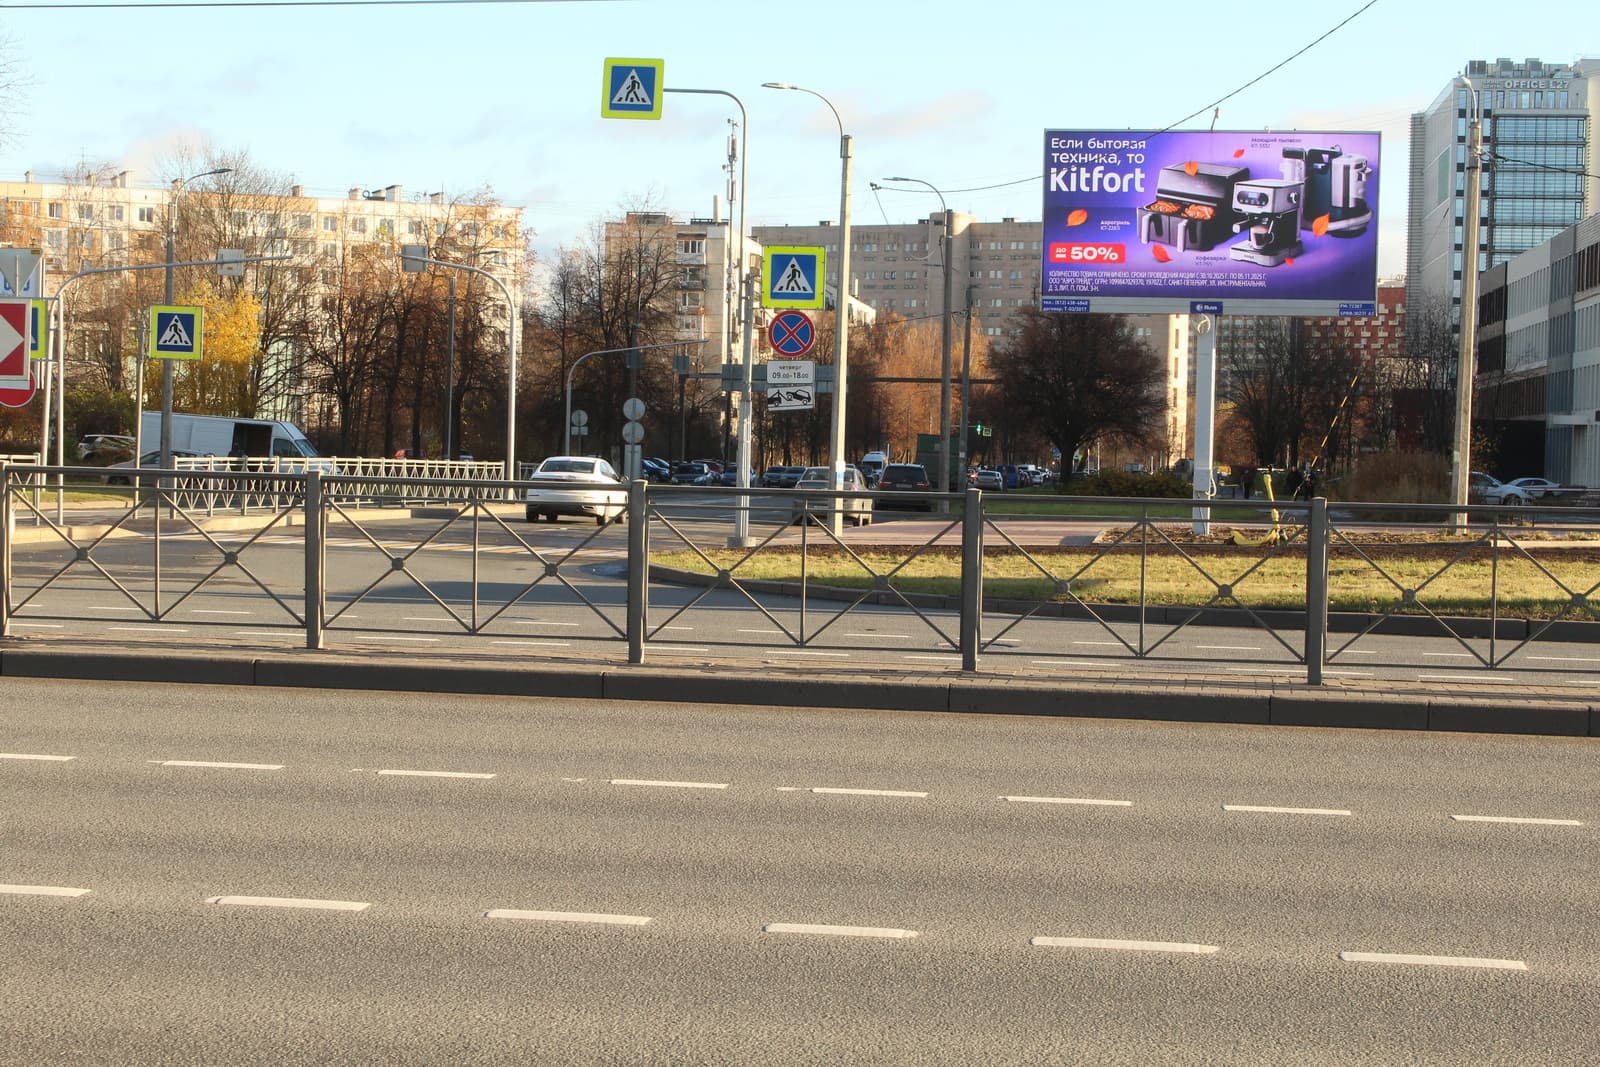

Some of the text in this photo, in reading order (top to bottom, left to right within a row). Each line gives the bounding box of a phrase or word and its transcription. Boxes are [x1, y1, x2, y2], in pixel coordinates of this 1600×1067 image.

[1504, 80, 1545, 89] OFFICE
[1052, 138, 1146, 150] Если бытовая
[1052, 153, 1145, 165] техника, то
[1050, 165, 1146, 192] Kitfort
